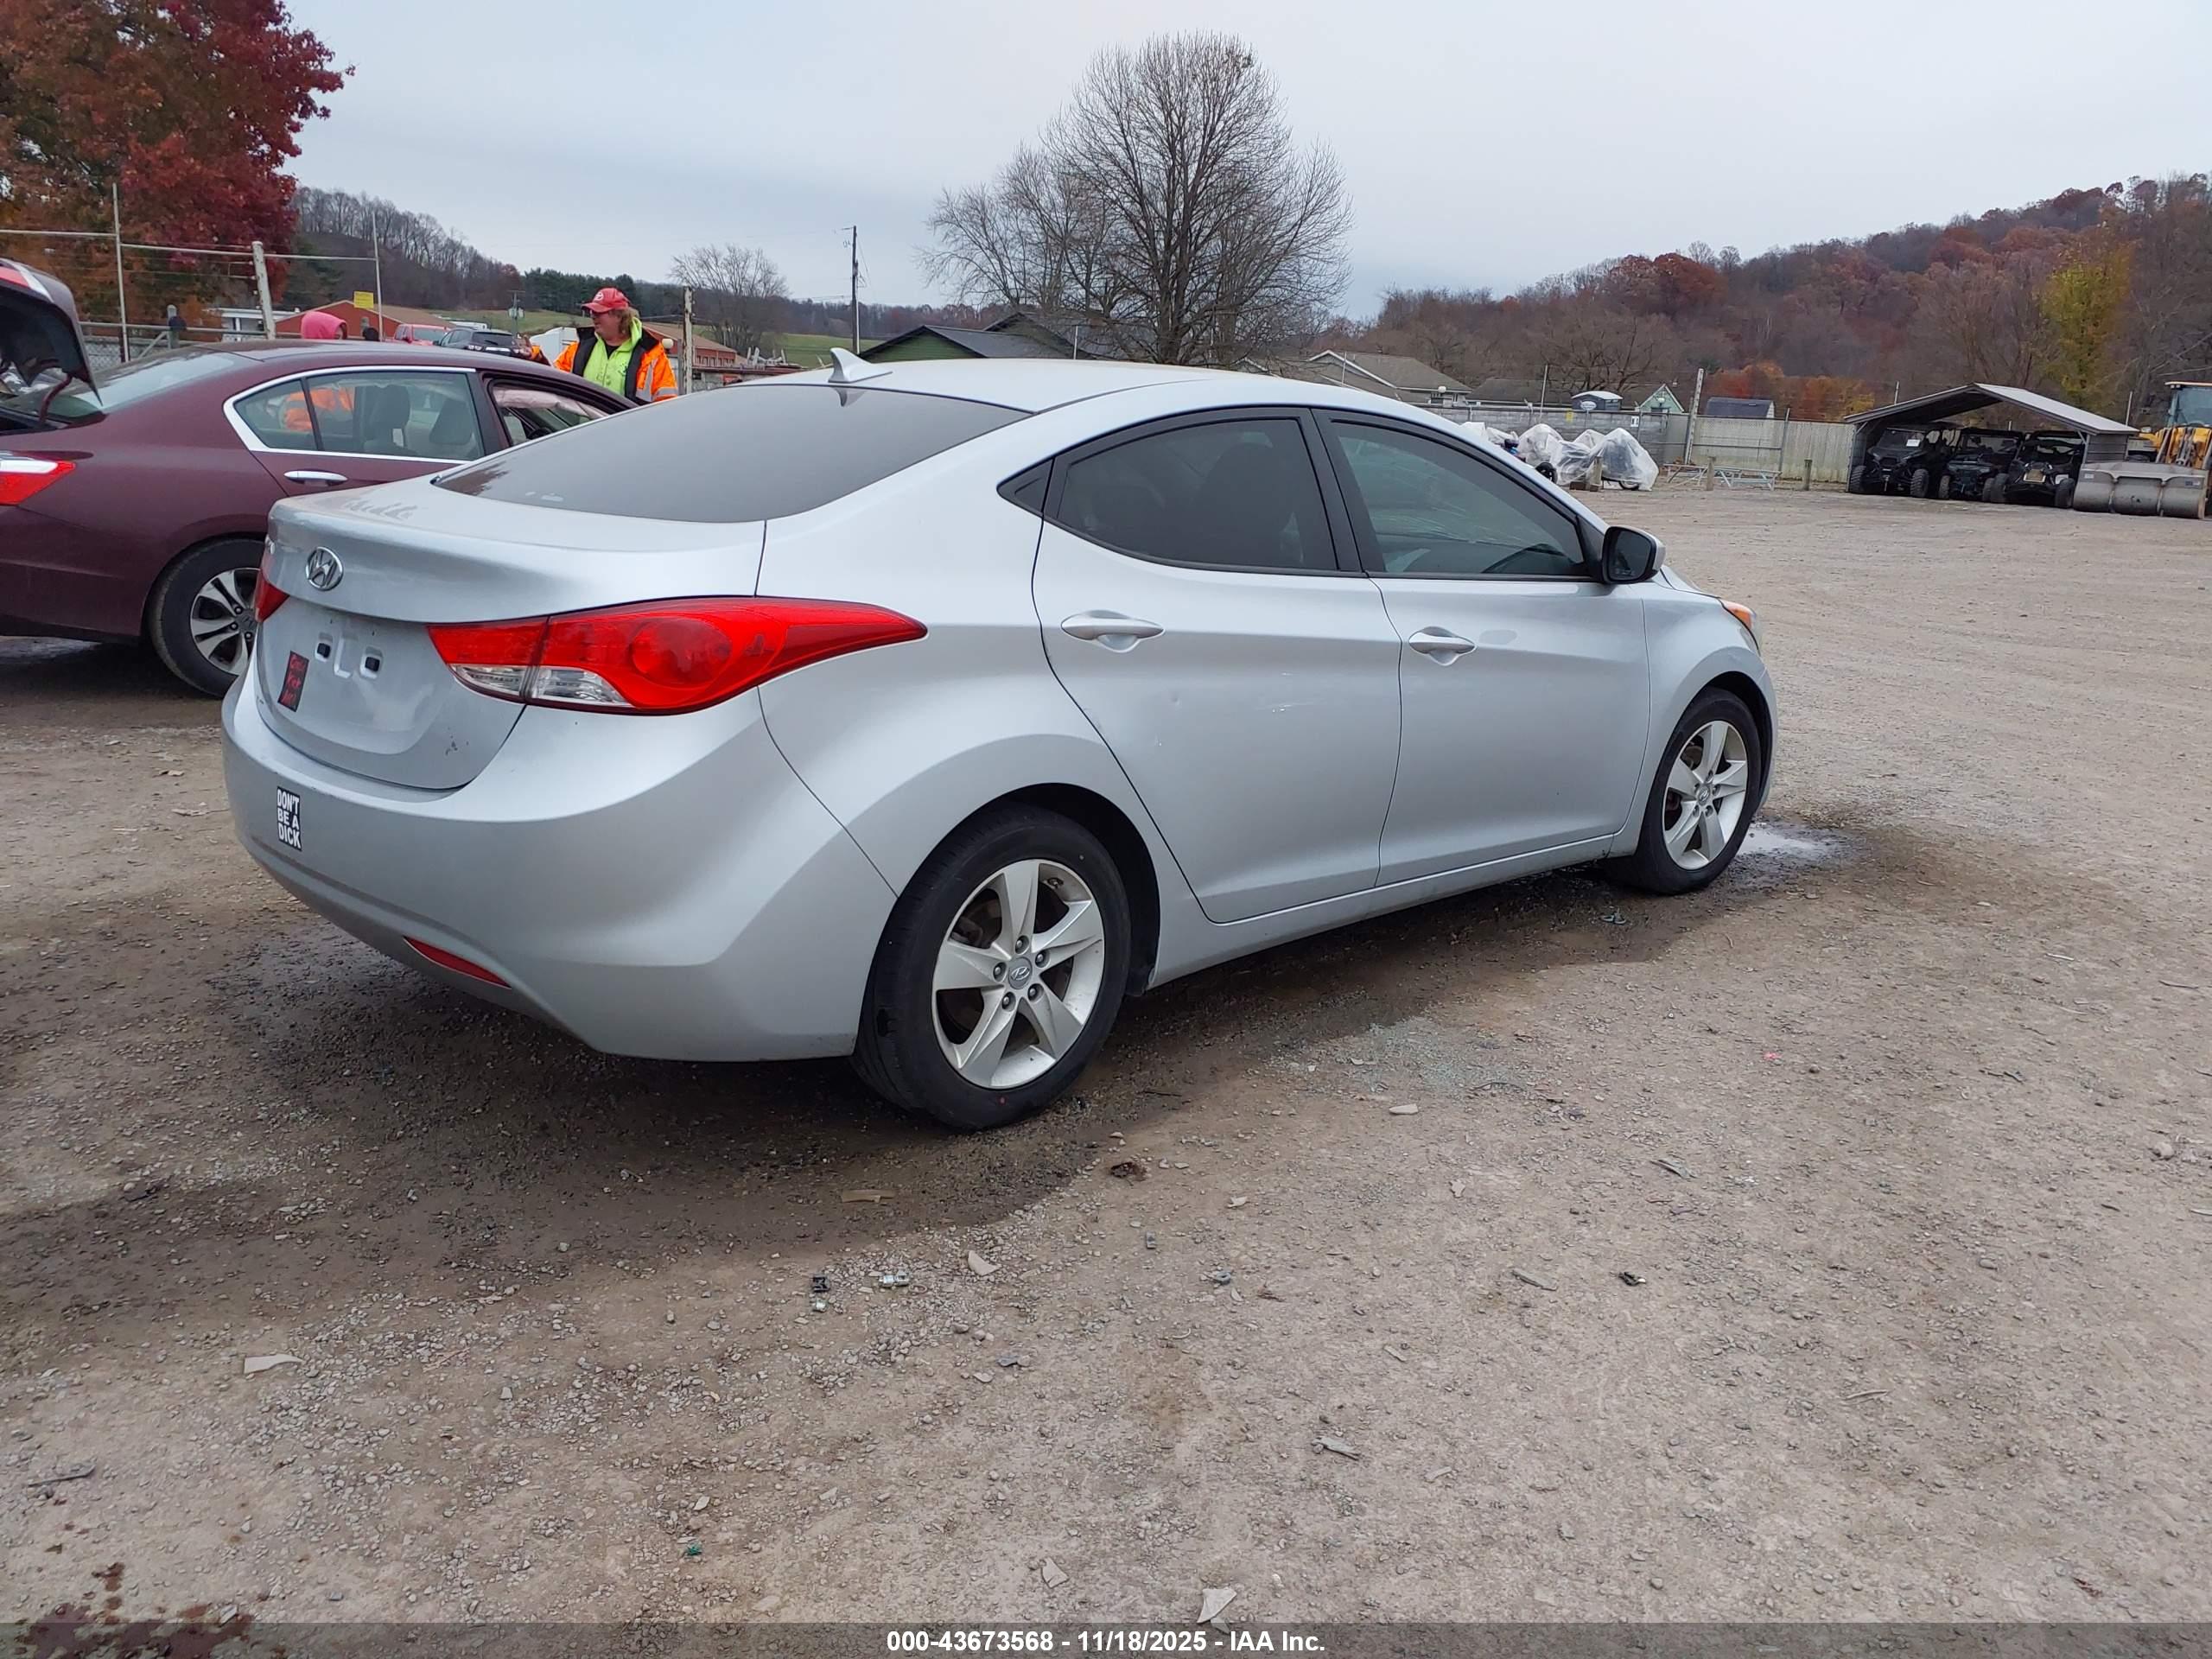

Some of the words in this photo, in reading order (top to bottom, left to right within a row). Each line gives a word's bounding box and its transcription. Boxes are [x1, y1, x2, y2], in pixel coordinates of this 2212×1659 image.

[277, 788, 300, 815] DON'T
[277, 807, 290, 826] BE
[292, 815, 300, 830] A
[278, 822, 302, 849] DICK
